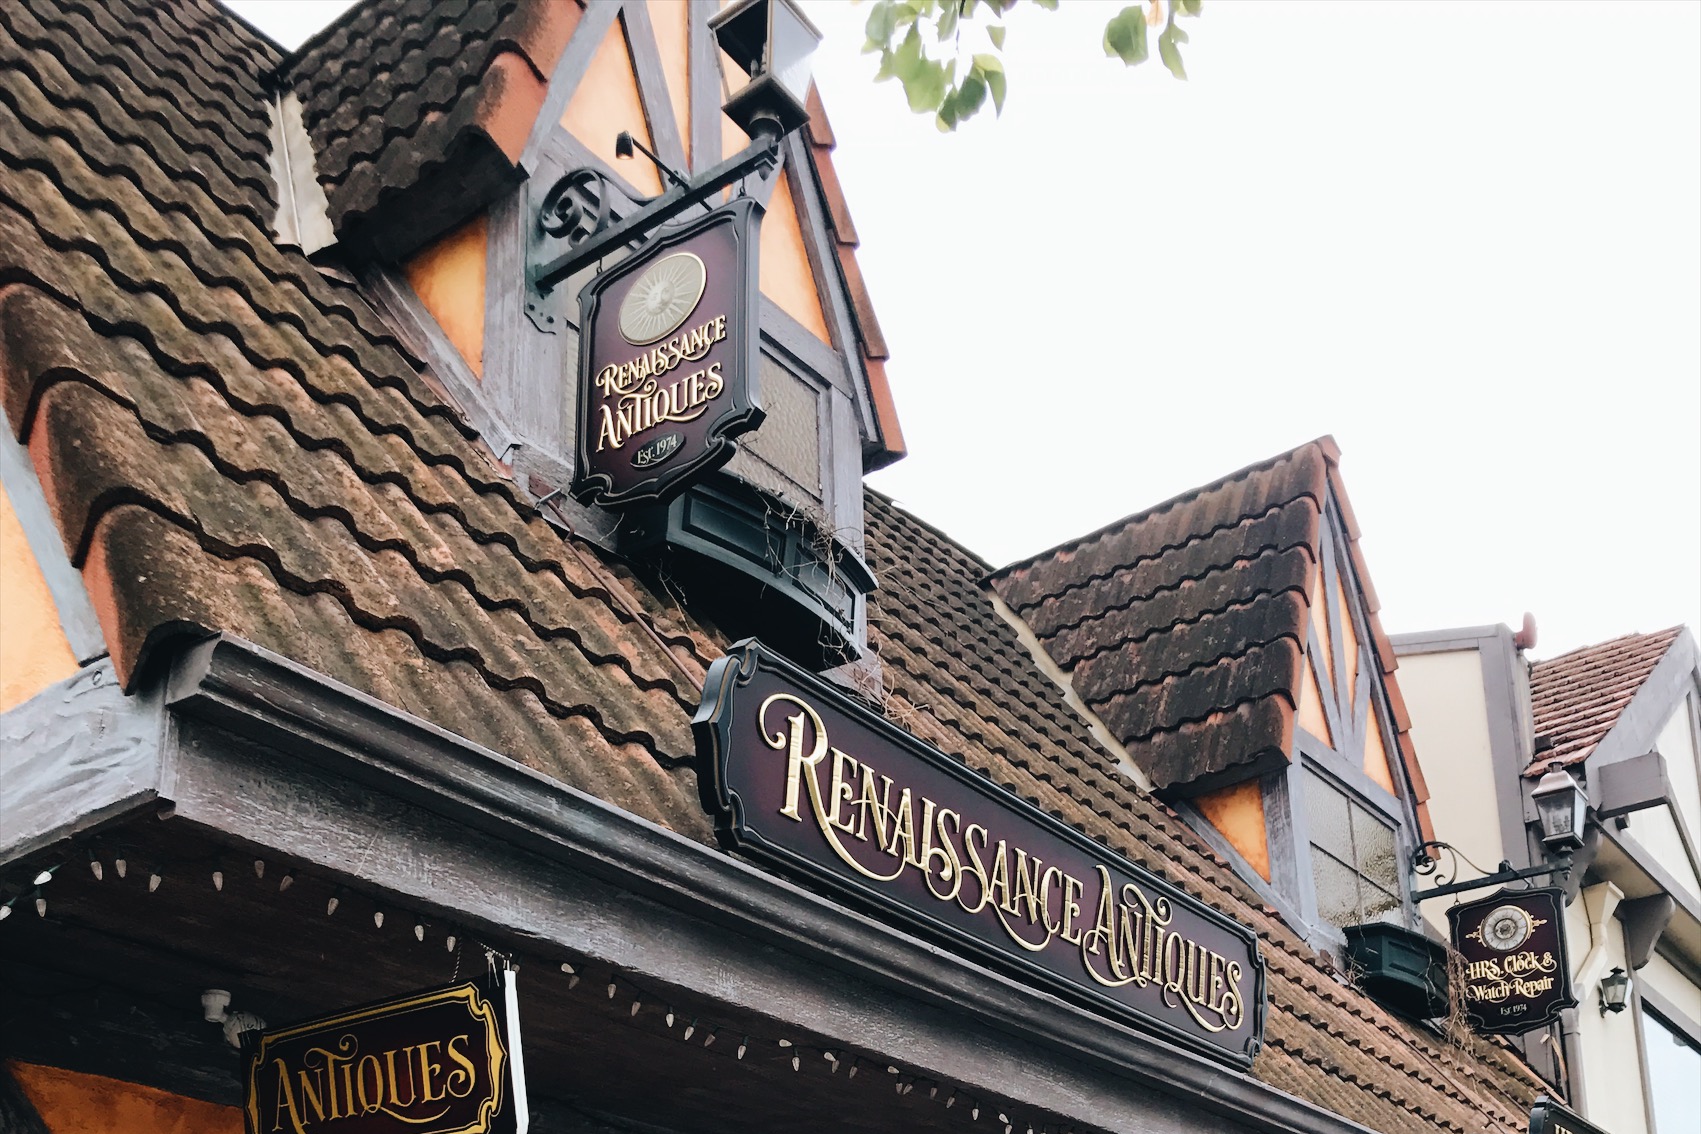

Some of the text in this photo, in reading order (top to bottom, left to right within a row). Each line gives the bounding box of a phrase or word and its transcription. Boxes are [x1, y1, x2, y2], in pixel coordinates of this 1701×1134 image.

[595, 315, 727, 398] RENAISSANCE
[596, 362, 724, 452] ANTIQUES
[656, 434, 677, 455] 1974
[758, 693, 1244, 1032] RENAISSANCE ANTIQUES
[1504, 951, 1540, 977] Clock
[1541, 952, 1557, 972] &
[1466, 976, 1555, 1003] Watch Repair
[1513, 1004, 1527, 1013] 1974
